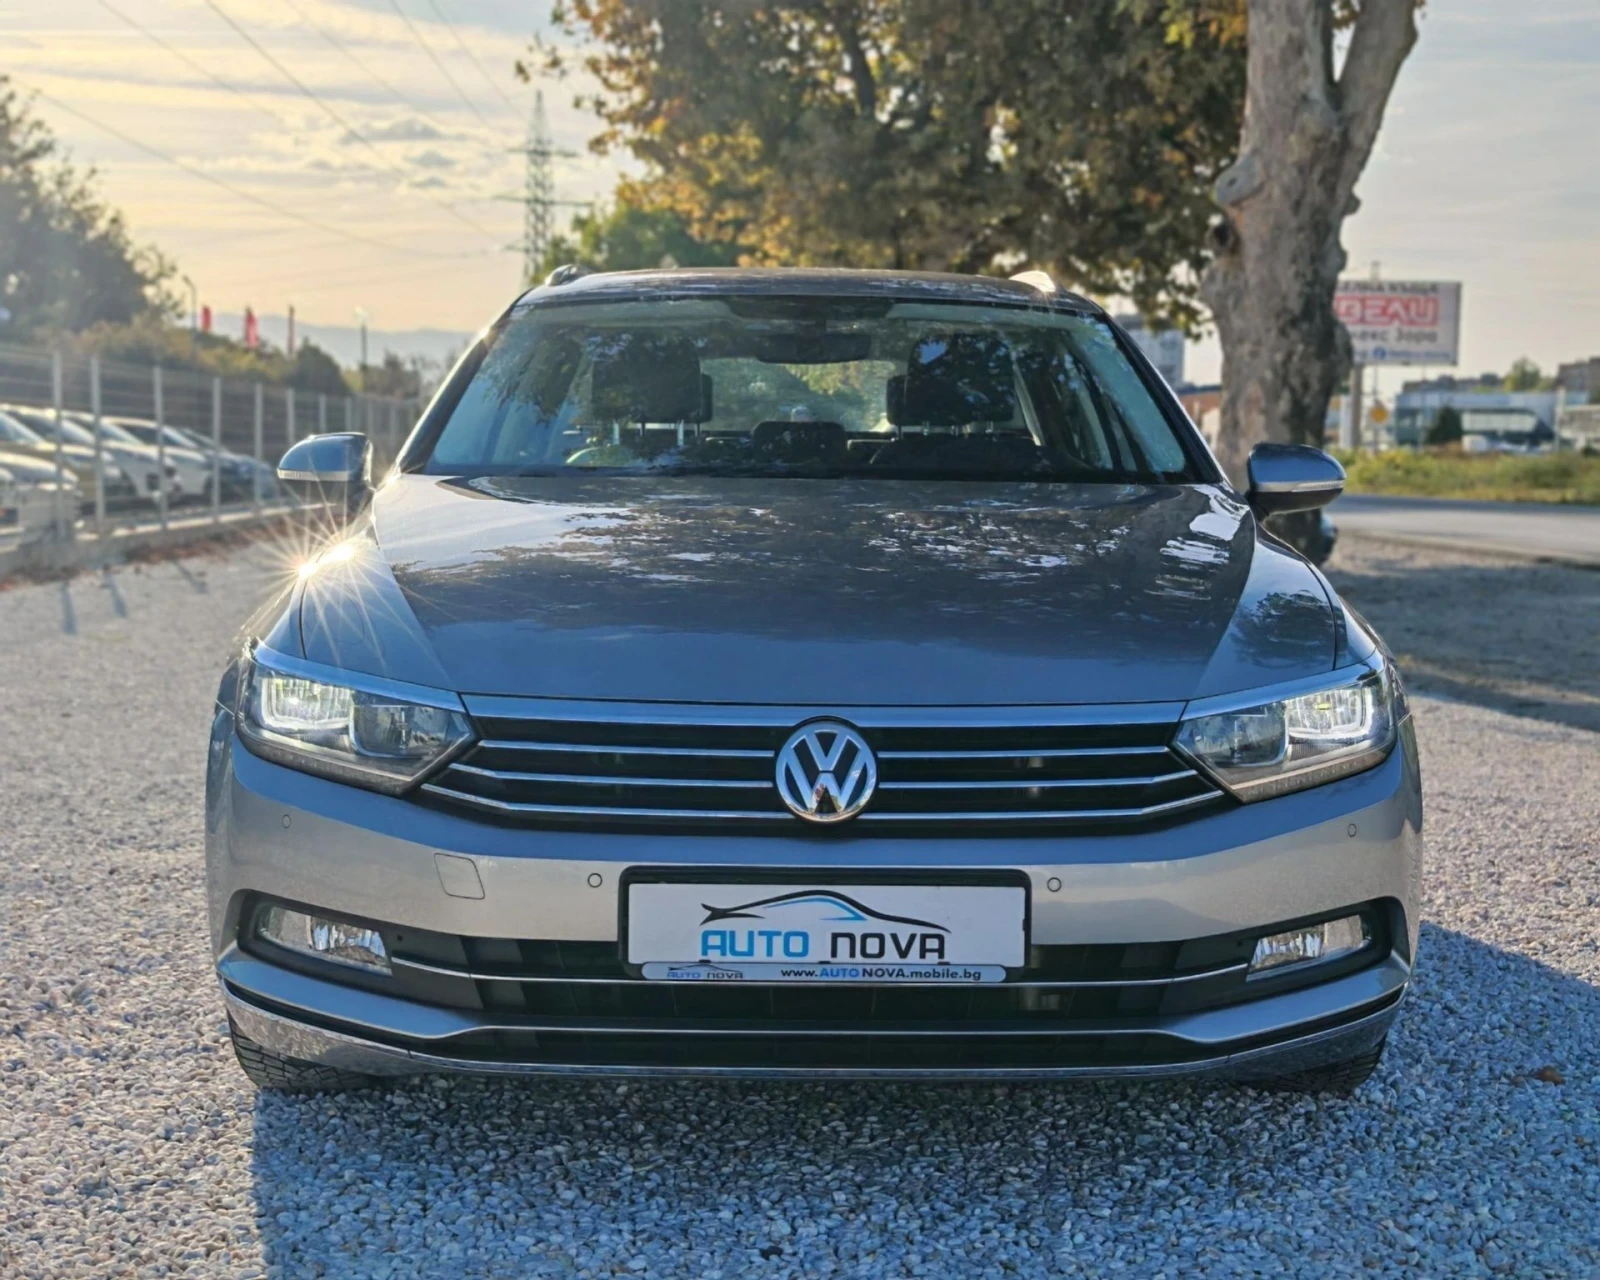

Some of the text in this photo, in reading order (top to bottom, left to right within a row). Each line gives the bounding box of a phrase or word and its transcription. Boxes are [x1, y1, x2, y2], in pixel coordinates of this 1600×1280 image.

[701, 930, 946, 960] AUTO NOVA
[666, 971, 744, 979] AUTO NOVA
